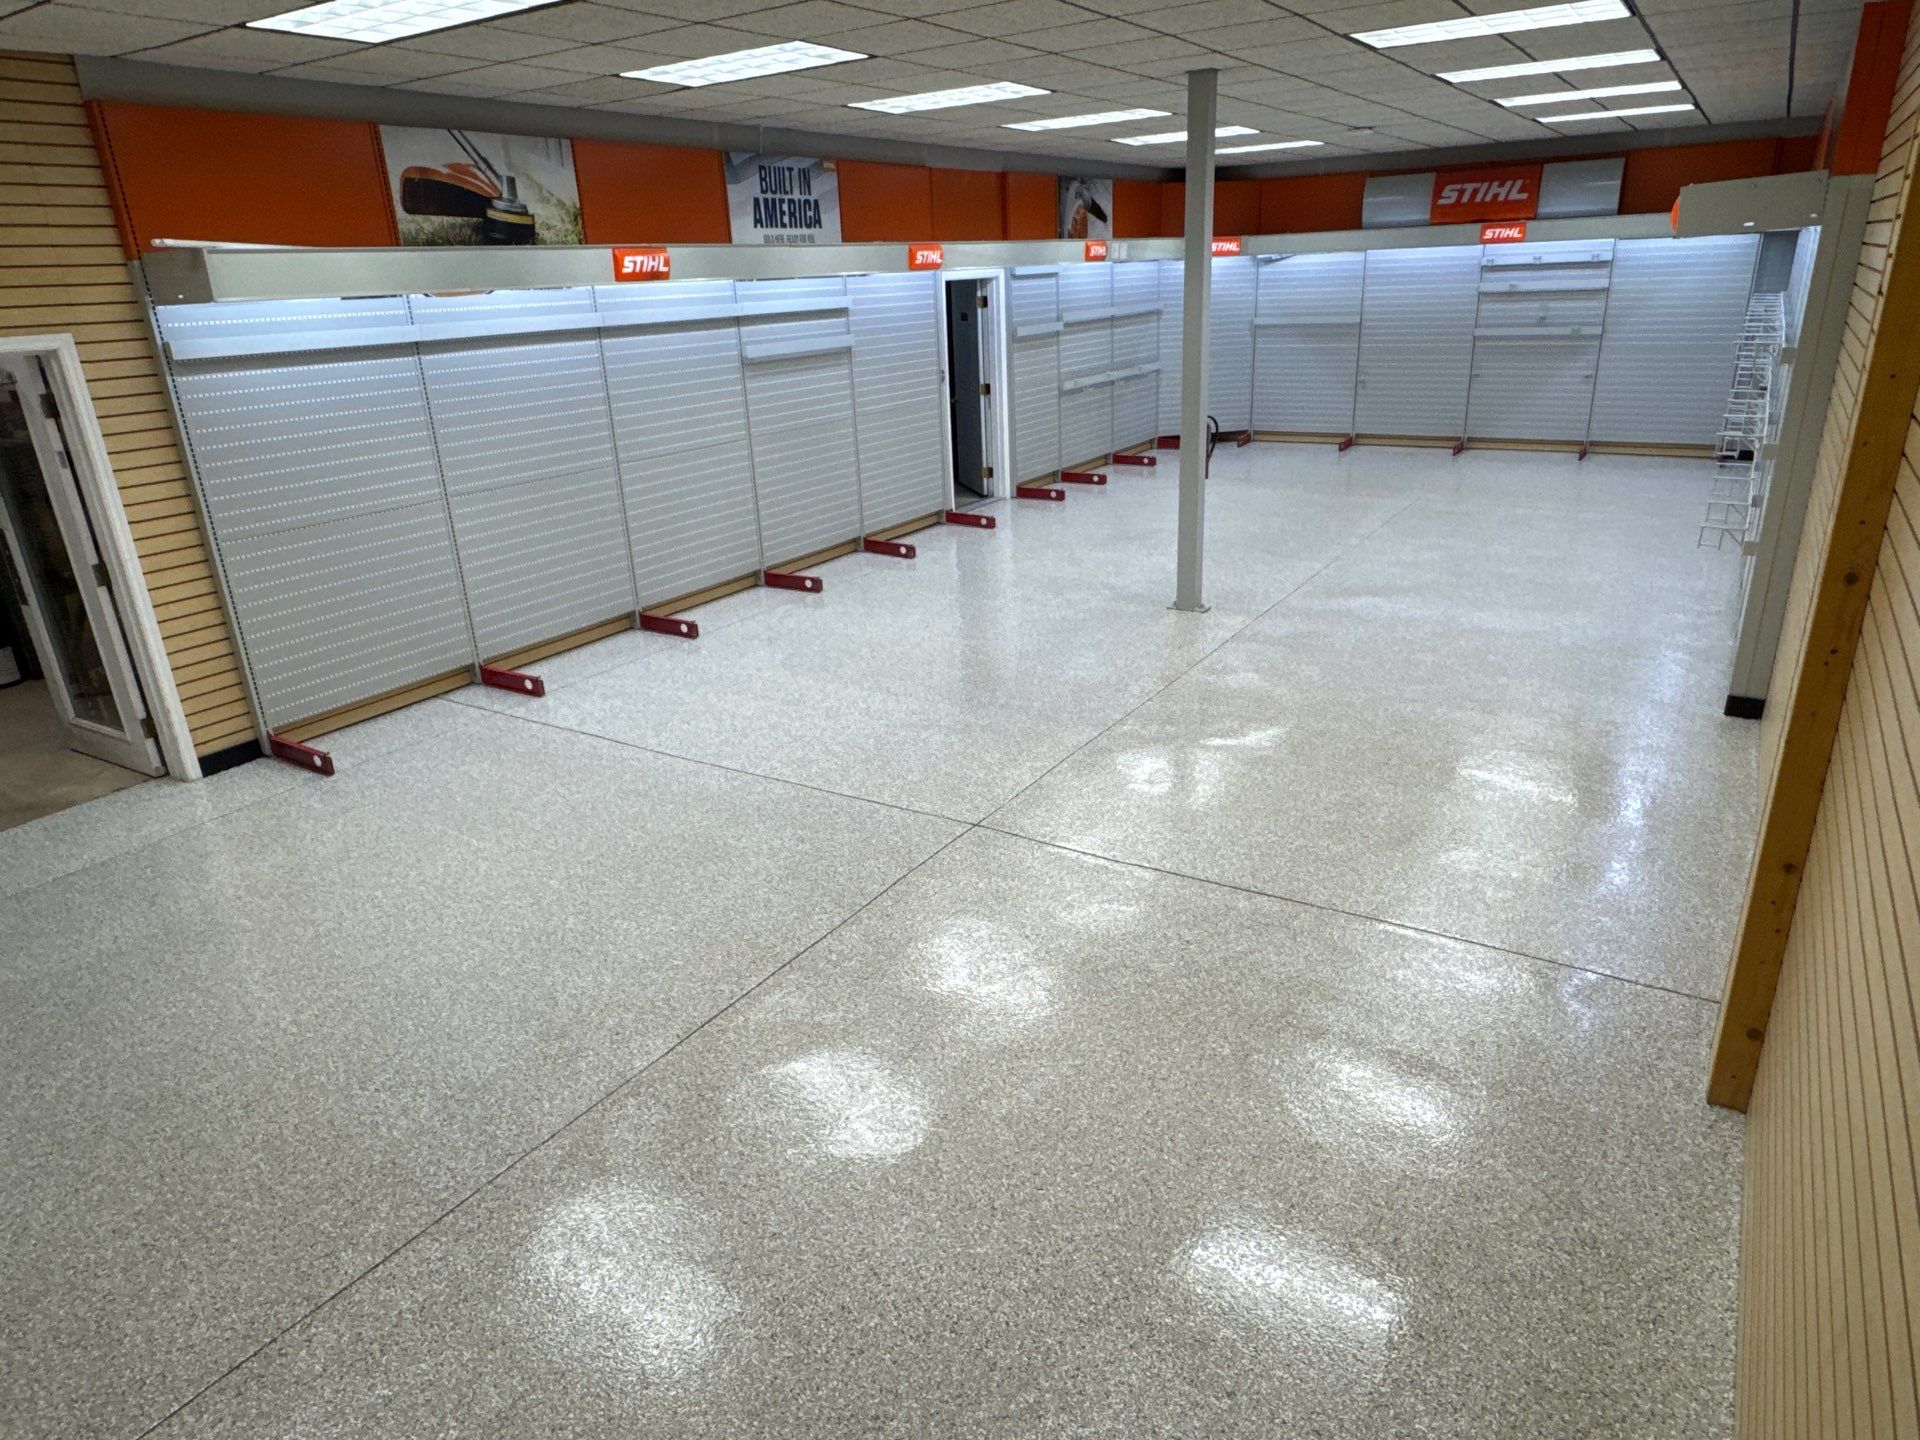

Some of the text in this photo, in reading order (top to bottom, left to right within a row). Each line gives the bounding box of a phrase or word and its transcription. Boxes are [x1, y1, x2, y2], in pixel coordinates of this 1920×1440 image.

[758, 165, 811, 196] BUILT IN
[1437, 179, 1529, 205] STIHL
[753, 197, 822, 229] AMERICA
[1483, 227, 1522, 239] STIHL
[622, 255, 669, 273] STIHL
[915, 250, 942, 264] STIHL
